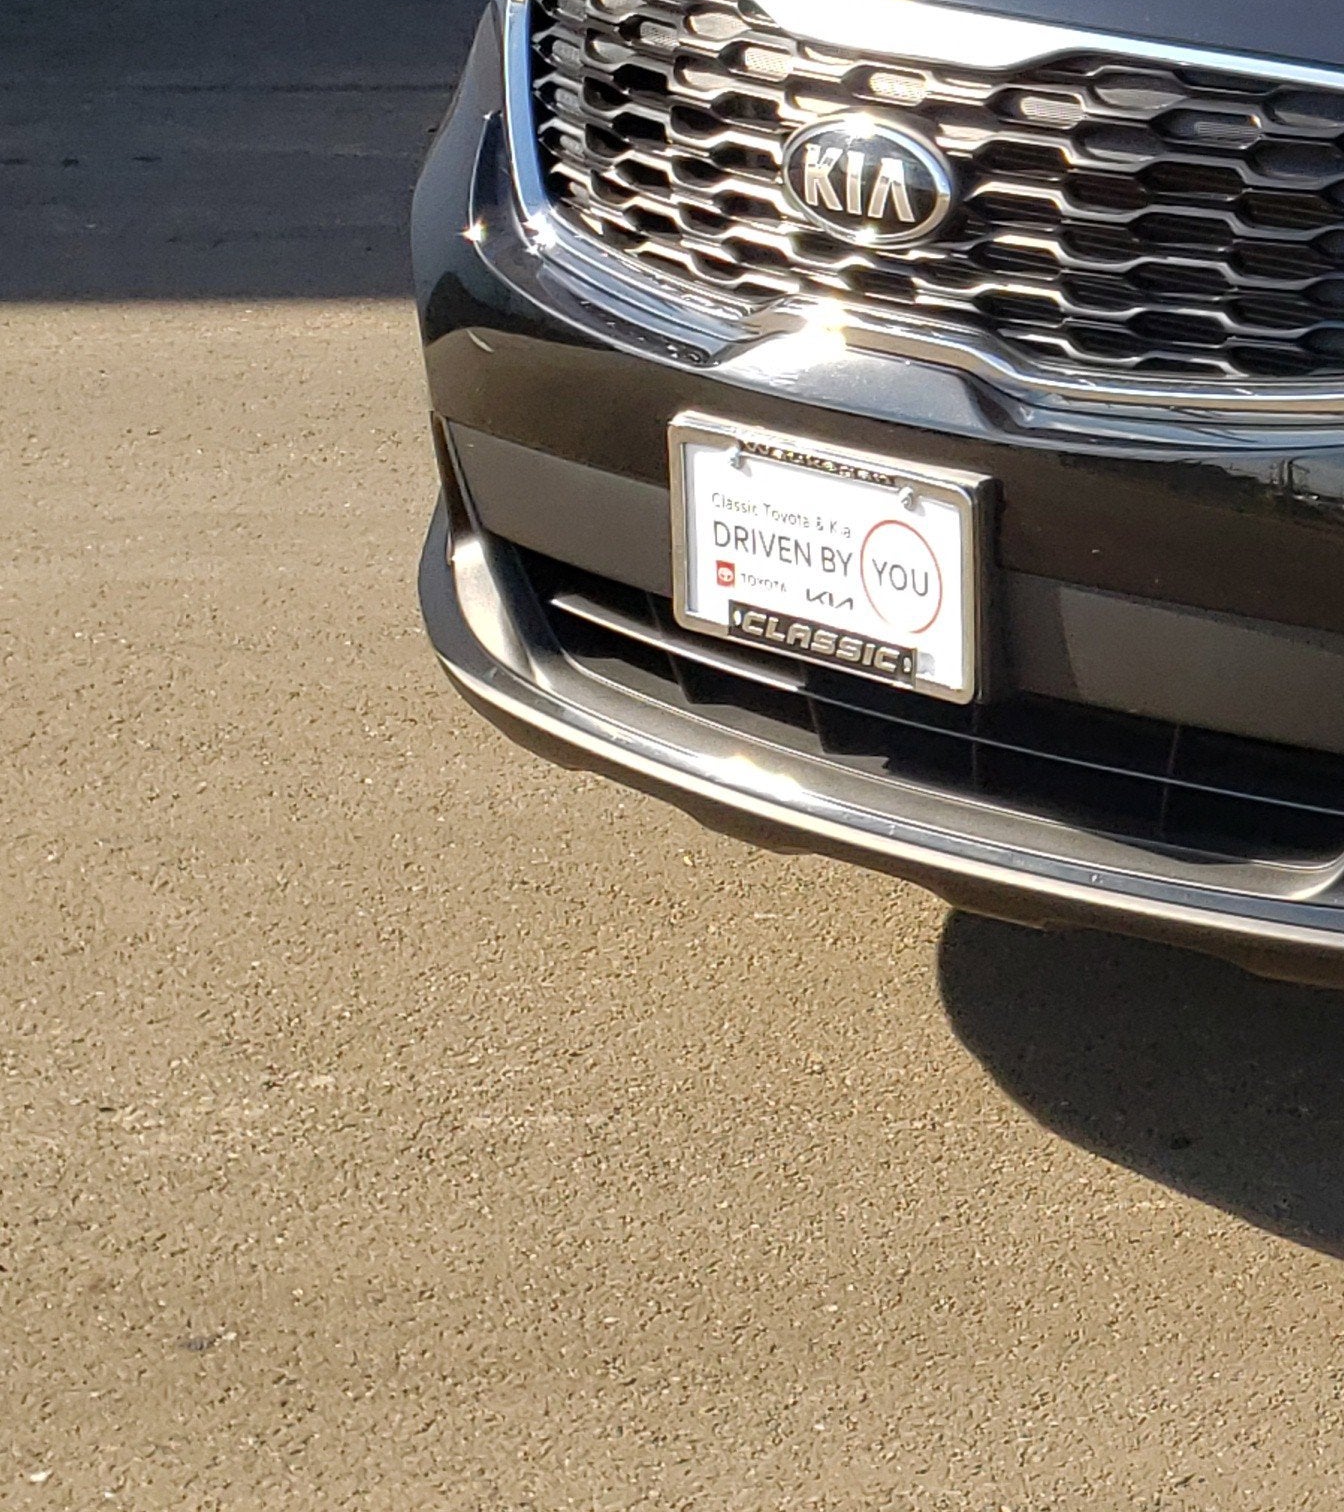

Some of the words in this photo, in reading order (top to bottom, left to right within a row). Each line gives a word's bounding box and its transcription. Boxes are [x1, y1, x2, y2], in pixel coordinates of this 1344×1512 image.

[803, 142, 916, 224] KIA
[713, 520, 812, 568] DRIVEN
[820, 545, 853, 577] BY
[872, 558, 930, 597] YOU
[829, 520, 851, 539] Ka
[742, 610, 900, 673] CLASSIC
